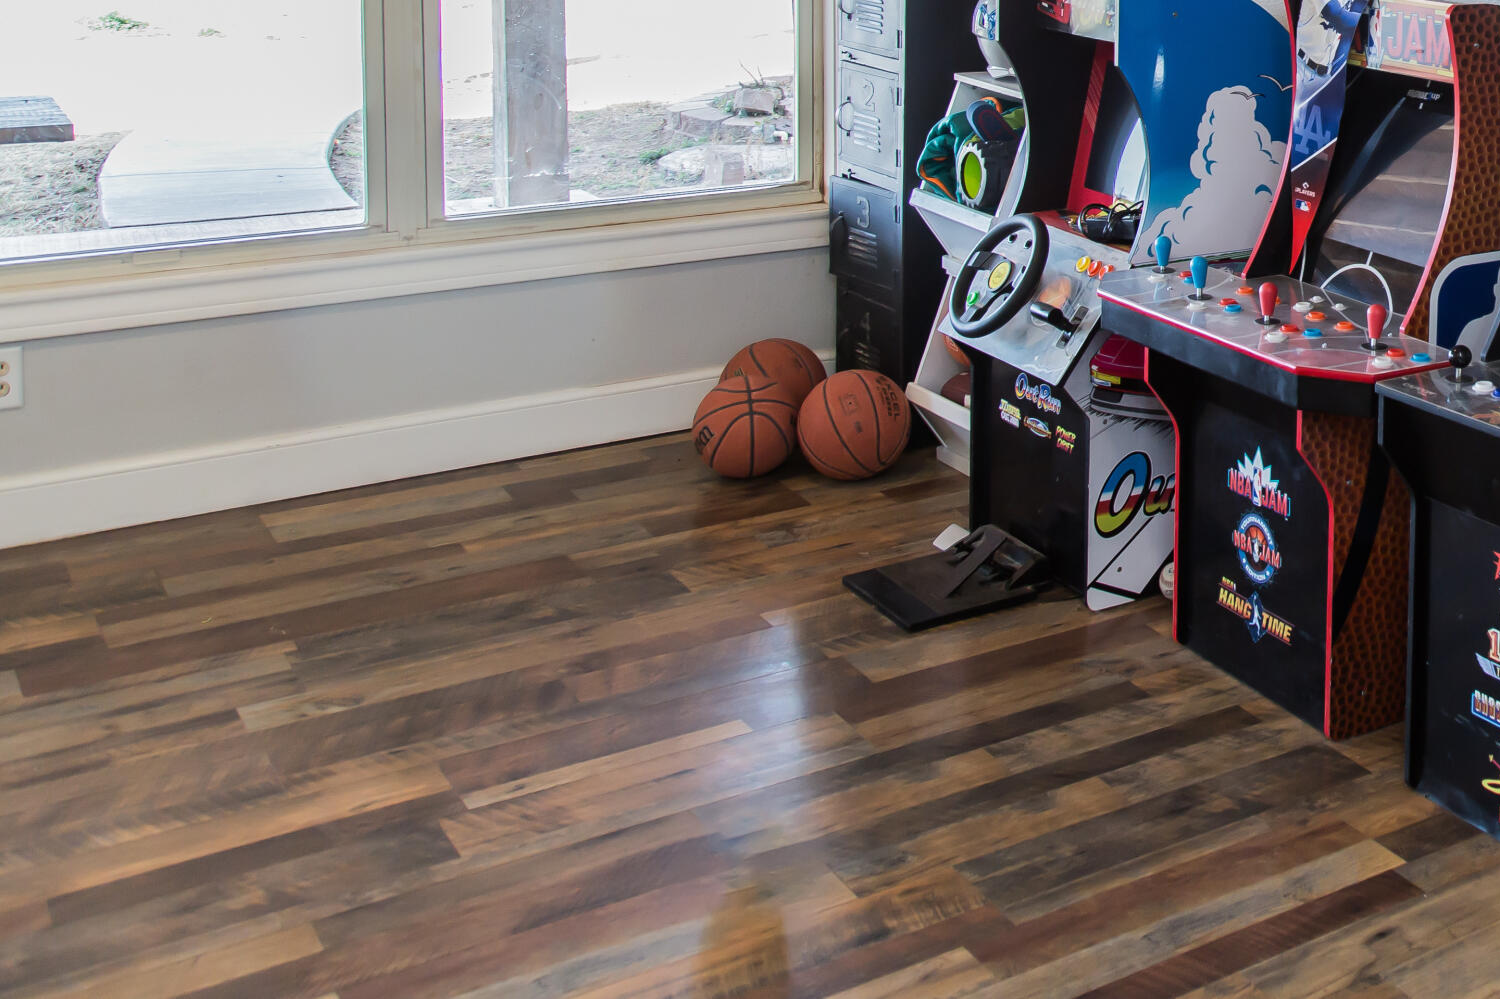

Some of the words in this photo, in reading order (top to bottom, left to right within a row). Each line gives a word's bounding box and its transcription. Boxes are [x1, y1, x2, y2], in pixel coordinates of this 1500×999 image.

[1387, 11, 1451, 69] JAM
[856, 195, 870, 229] 3
[1229, 467, 1252, 500] NBA
[1261, 484, 1289, 517] JAM
[1232, 529, 1253, 554] NBA
[1259, 544, 1281, 569] JAM
[1218, 587, 1253, 620] HANG
[1261, 611, 1293, 643] TIME
